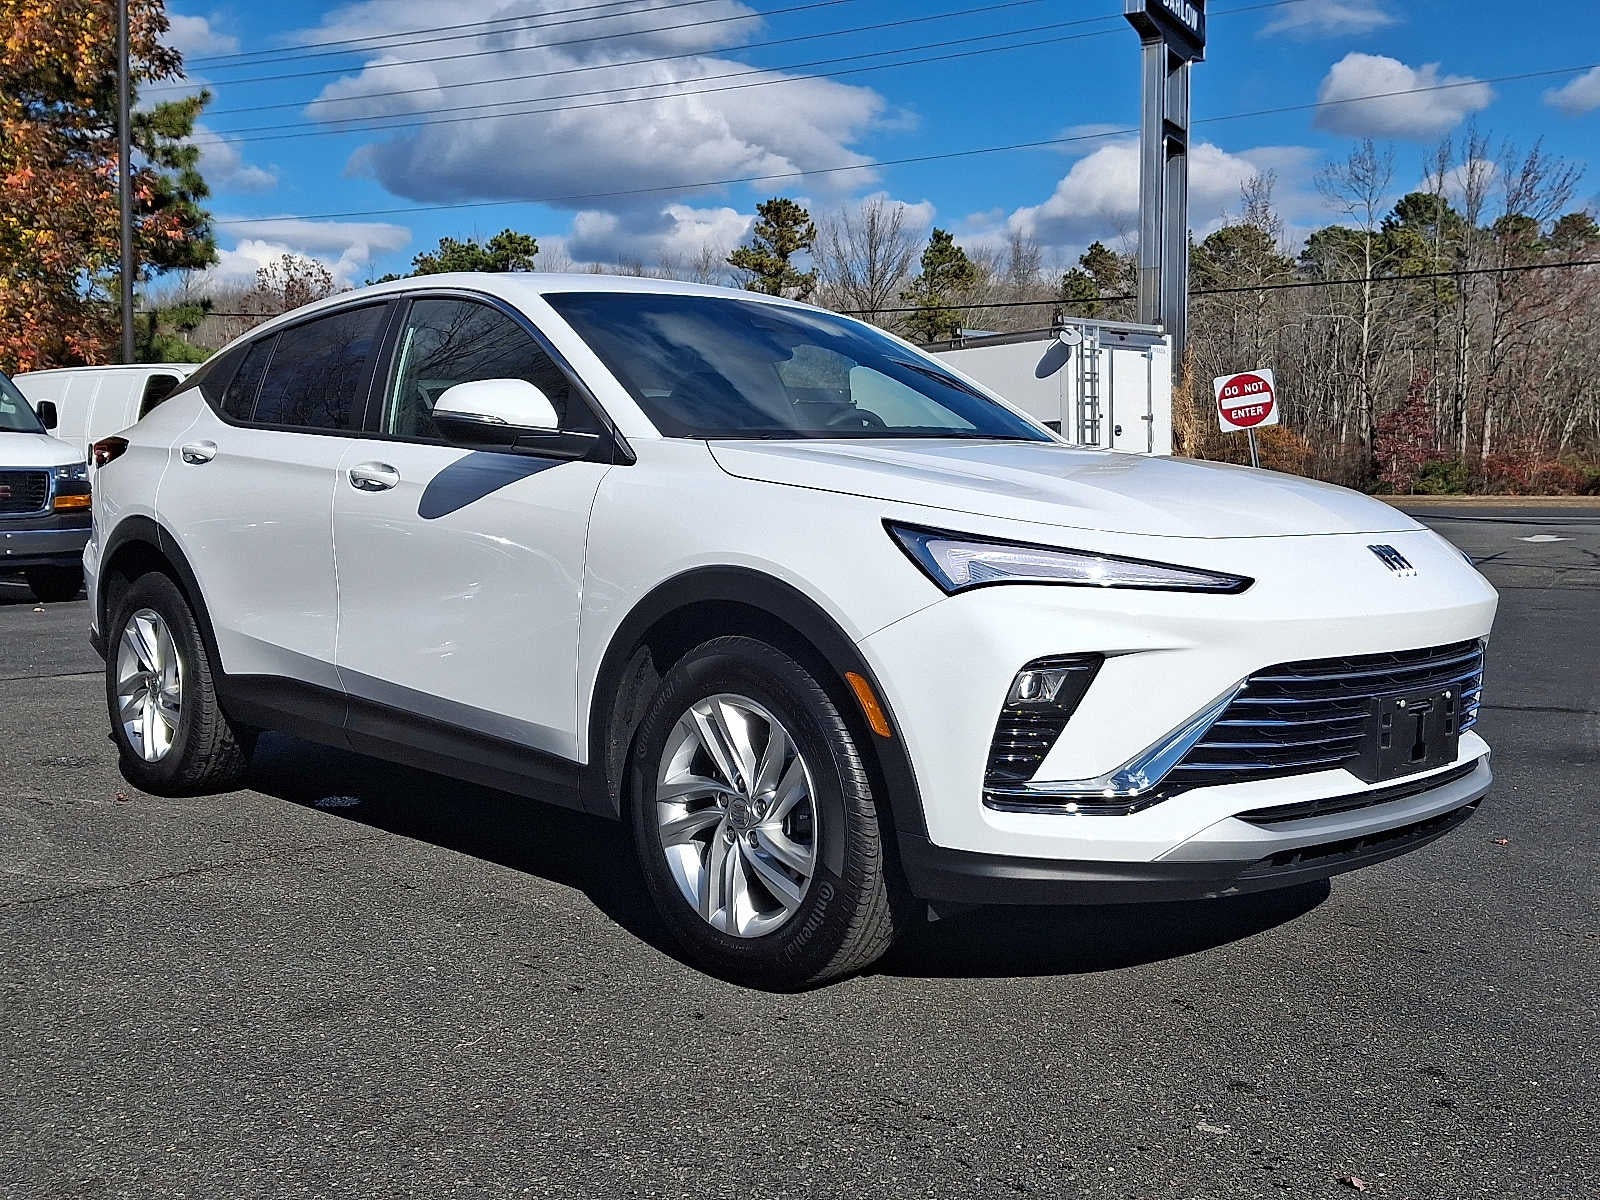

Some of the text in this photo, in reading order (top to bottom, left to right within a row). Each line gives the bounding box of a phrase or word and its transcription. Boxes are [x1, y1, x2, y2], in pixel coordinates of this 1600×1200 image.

[1224, 381, 1264, 396] DO NOT
[1231, 406, 1264, 419] ENTER
